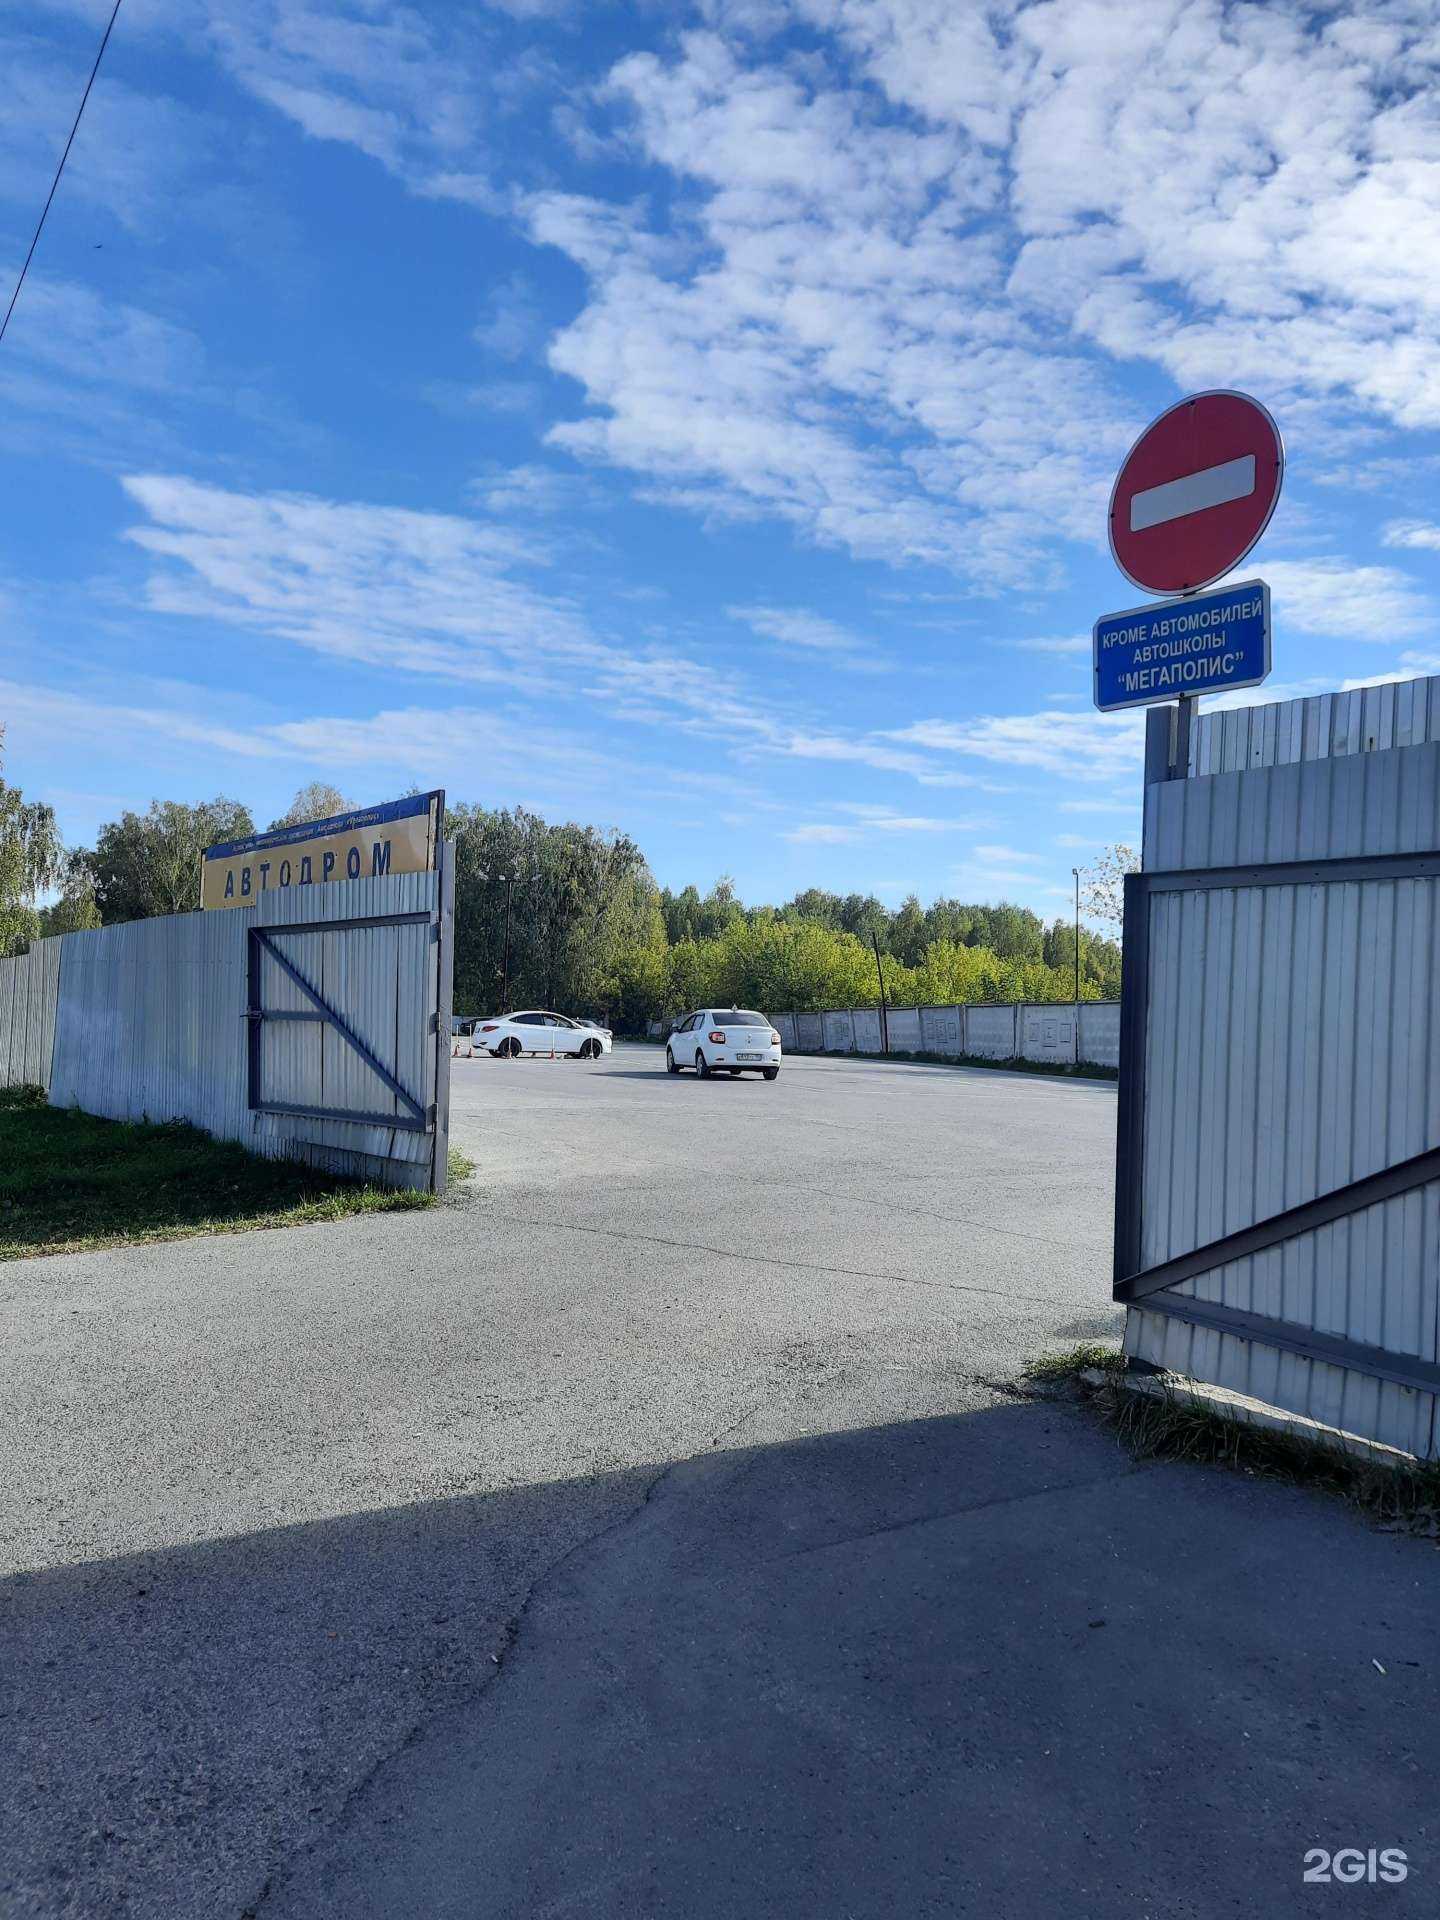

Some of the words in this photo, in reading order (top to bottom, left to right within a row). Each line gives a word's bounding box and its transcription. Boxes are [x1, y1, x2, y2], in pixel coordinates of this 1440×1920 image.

[1103, 625, 1147, 648] КРОМЕ
[1151, 598, 1263, 639] АВТОМОБИЛЕЙ
[1133, 631, 1226, 664] АВТОШКОЛЫ
[224, 840, 391, 898] АВТОДРОМ
